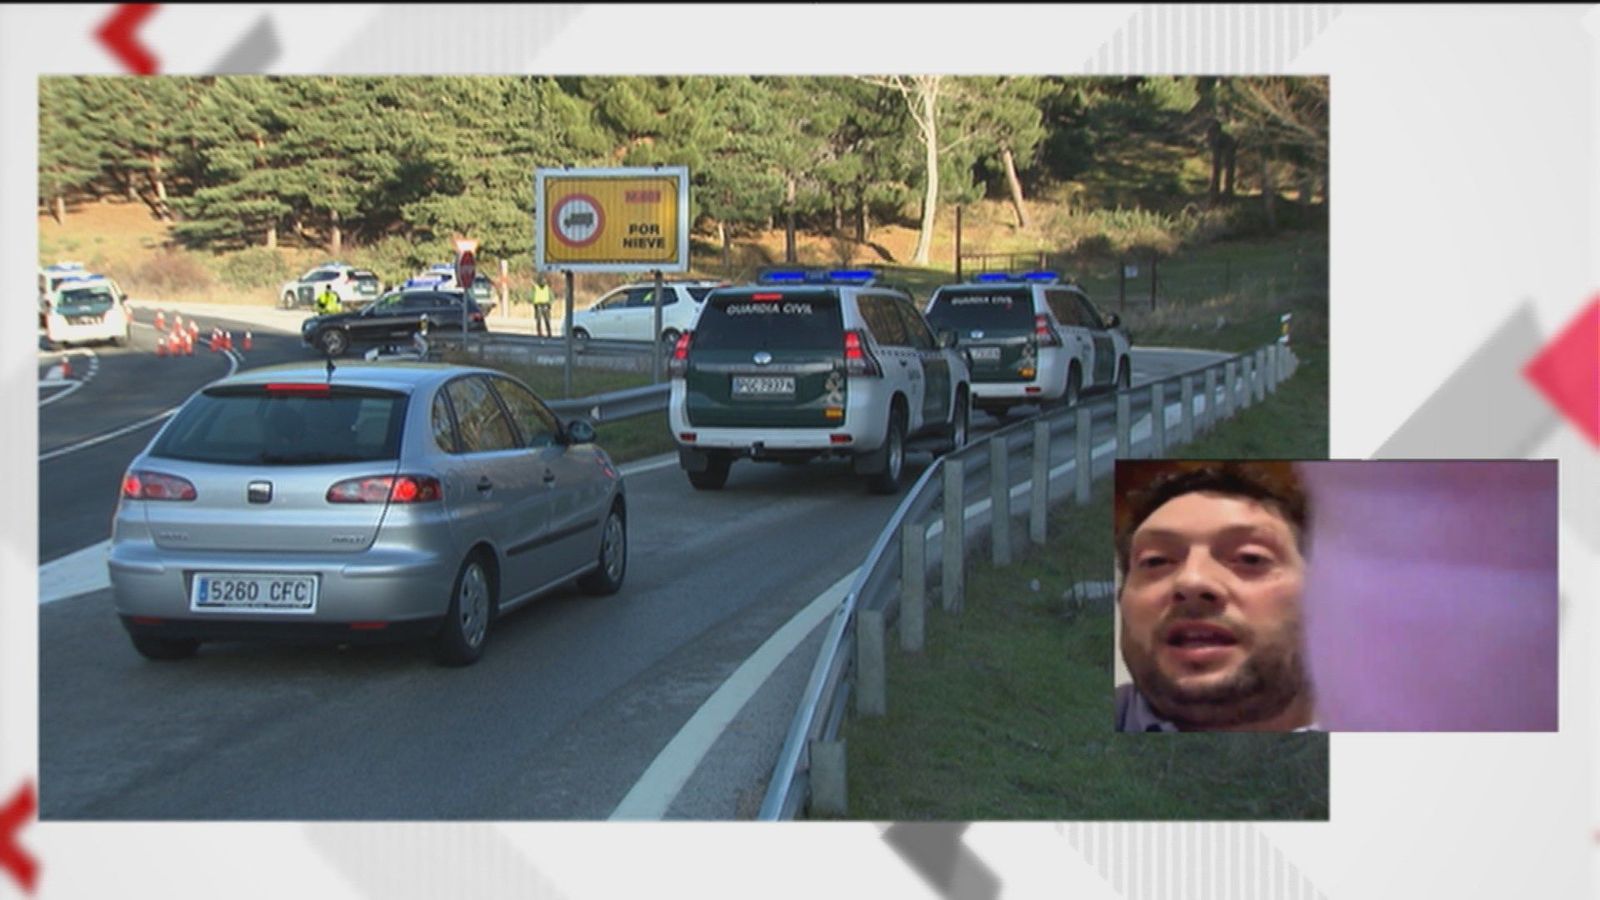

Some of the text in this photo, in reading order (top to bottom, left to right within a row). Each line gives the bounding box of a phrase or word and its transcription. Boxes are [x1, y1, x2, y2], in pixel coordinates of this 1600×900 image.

[628, 223, 660, 235] POR
[622, 237, 665, 249] NIEVE
[726, 302, 813, 316] GUARDIA CIVIL
[210, 580, 307, 601] 5260 CFC
